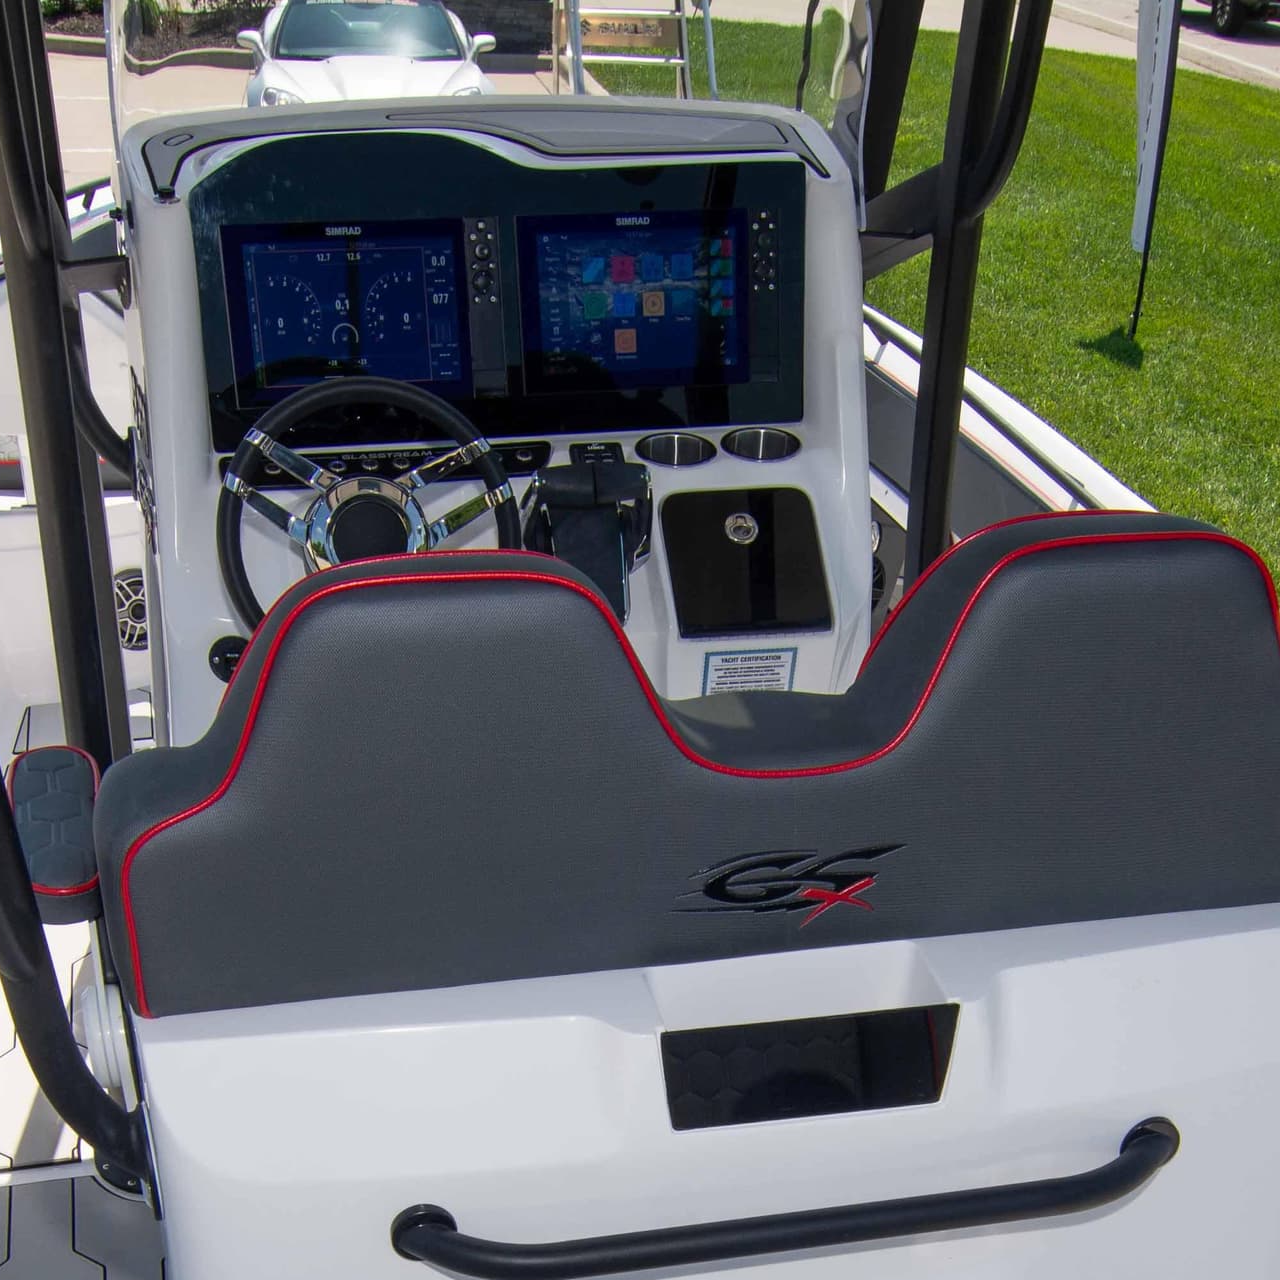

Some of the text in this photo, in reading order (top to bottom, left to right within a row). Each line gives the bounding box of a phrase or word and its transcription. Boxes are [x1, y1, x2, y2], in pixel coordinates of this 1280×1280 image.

[615, 216, 651, 226] SIMRAD
[324, 226, 362, 236] SIMRAD
[431, 255, 446, 267] 0.0
[335, 298, 350, 311] 0.1
[432, 293, 449, 305] 077
[341, 450, 433, 461] GLASSTREAM
[740, 655, 782, 663] CERTIFICATION
